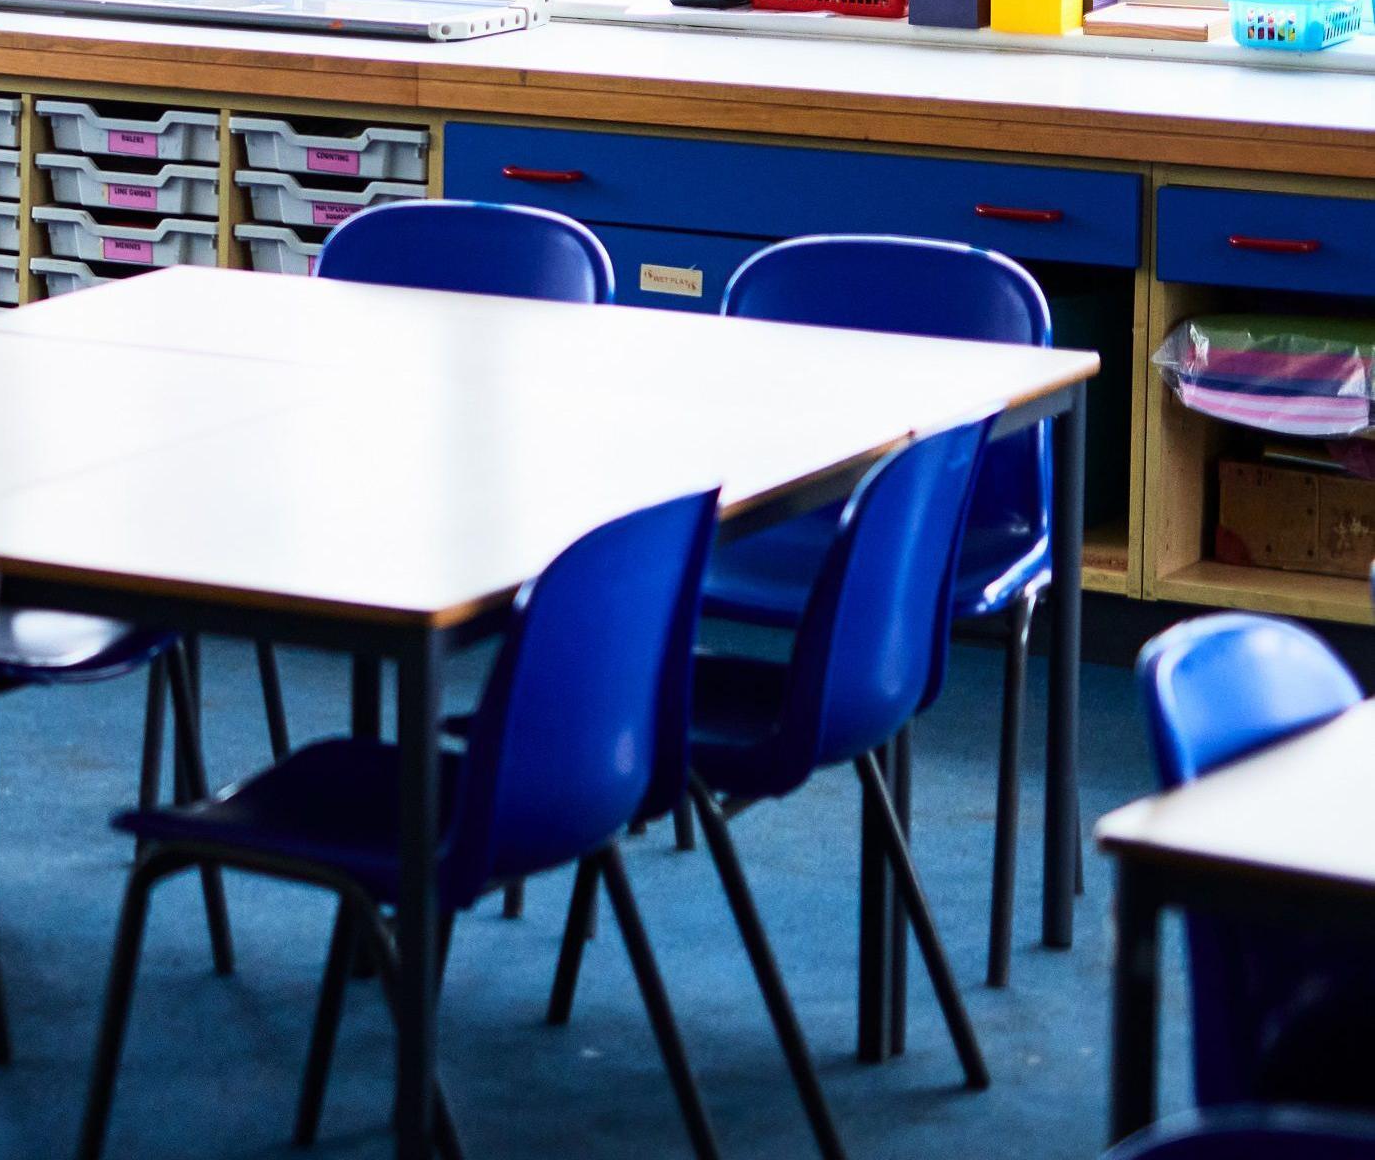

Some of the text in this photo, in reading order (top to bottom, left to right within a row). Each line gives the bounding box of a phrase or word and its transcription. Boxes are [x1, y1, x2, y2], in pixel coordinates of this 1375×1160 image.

[316, 151, 350, 162] COUNTING
[114, 186, 152, 198] LINE GUIDES
